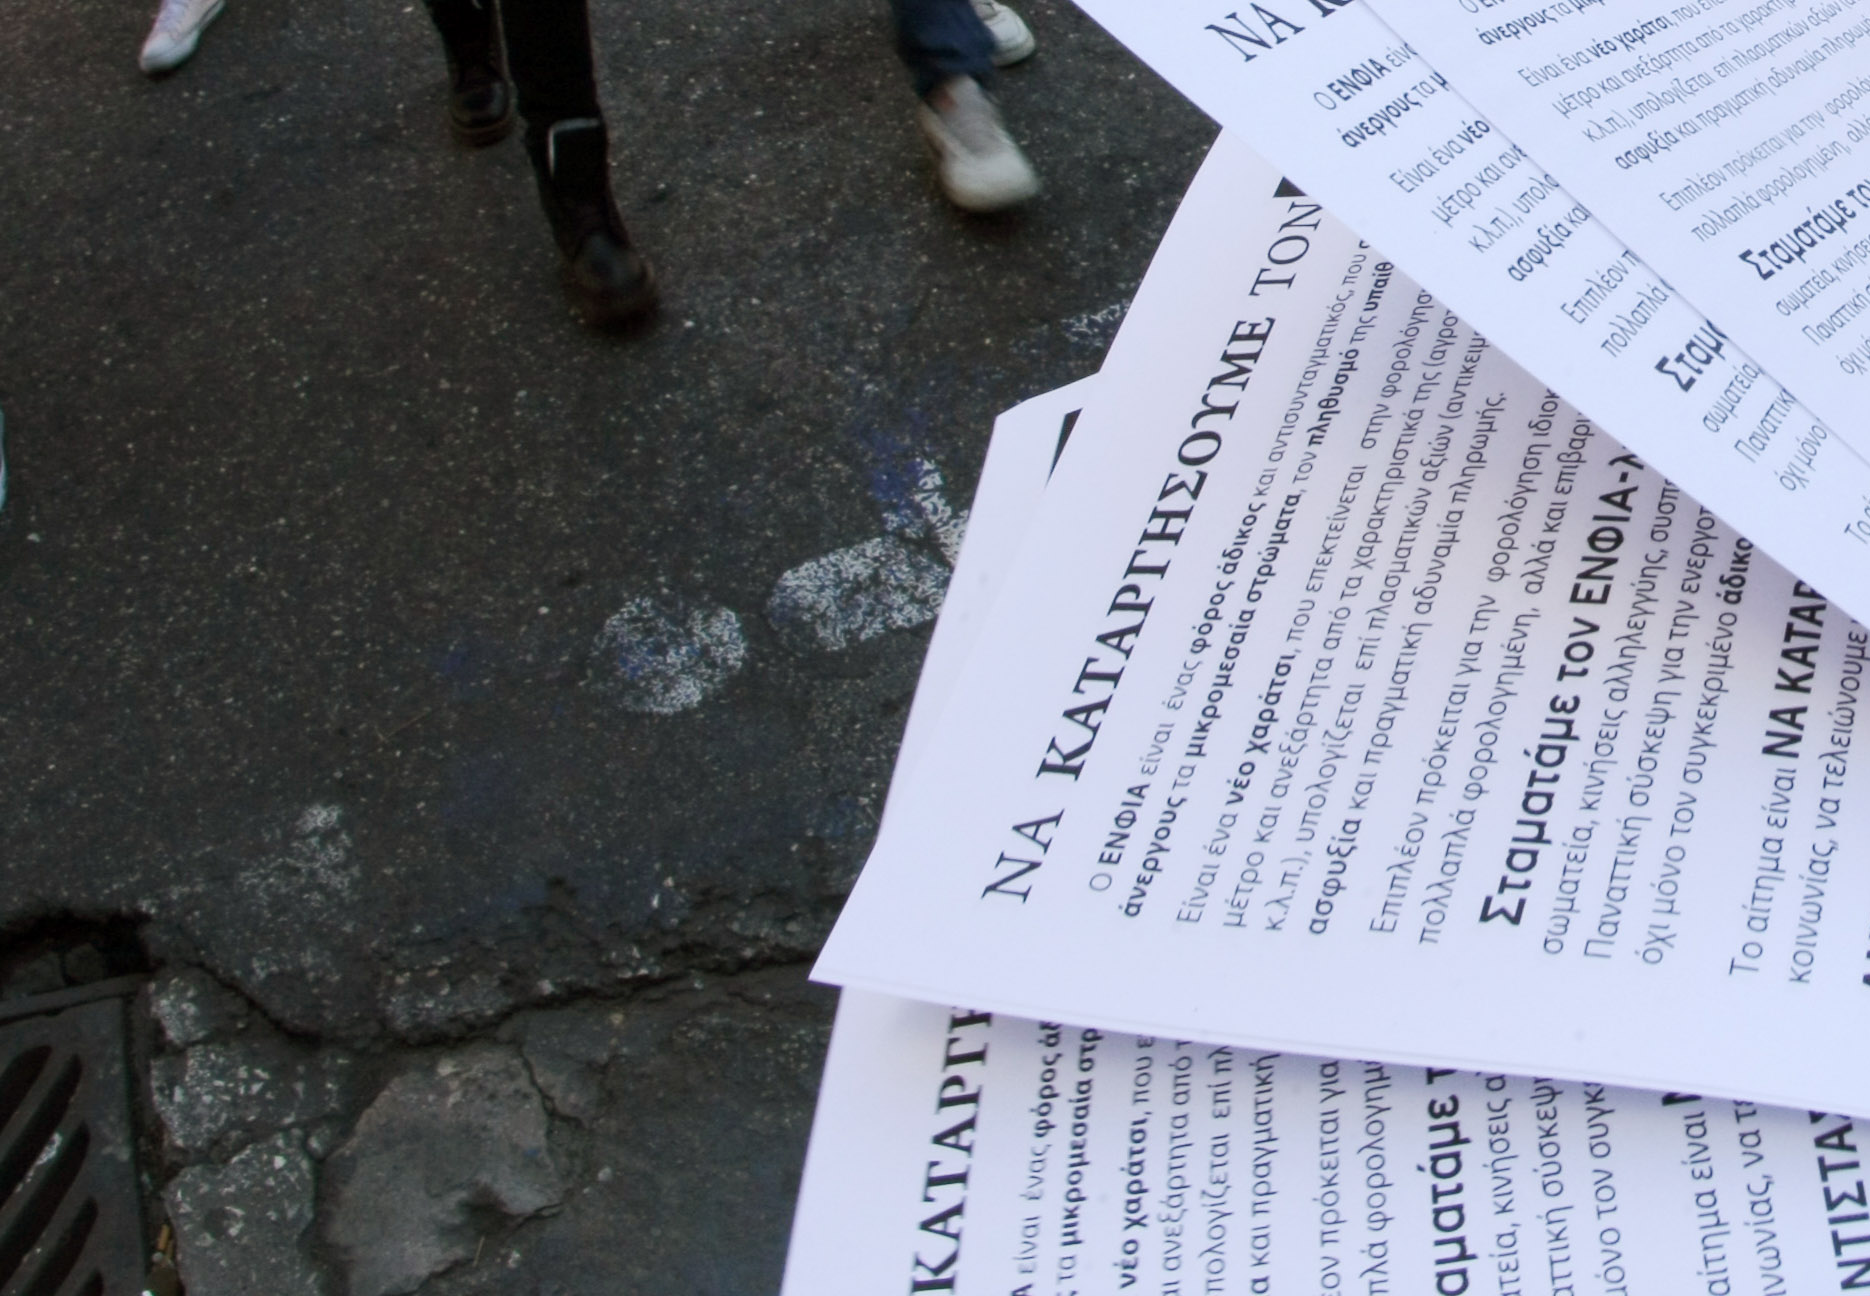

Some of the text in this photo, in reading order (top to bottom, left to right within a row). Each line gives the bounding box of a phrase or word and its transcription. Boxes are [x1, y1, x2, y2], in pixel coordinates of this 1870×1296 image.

[1203, 2, 1305, 62] ΝΑ
[1312, 57, 1391, 110] Ο ΕΝΦΙΑ
[1336, 79, 1436, 148] άνεργους τα
[1388, 119, 1490, 193] Είναι ένα νέο
[1738, 198, 1856, 281] Σταματάμε
[980, 206, 1325, 903] ΝΑ ΚΑΤΑΡΓΗΣΟΥΜΕ ΤΟΝ
[1088, 253, 1367, 892] Ο ΕΝΦΙΑ είναι ένας φόρος άδικος και αντισυνταγματικός, που
[1175, 649, 1300, 923] Είναι ένα νέο χαράτσι,
[1478, 449, 1645, 926] Σταματάμε τον ΕΝΦΙΑ-λ
[1727, 705, 1808, 975] Το αίτημα είναι ΝΑ
[1057, 1078, 1093, 1282] τα μικρομεσαία
[1113, 1054, 1154, 1289] νέο χαράτσι, που
